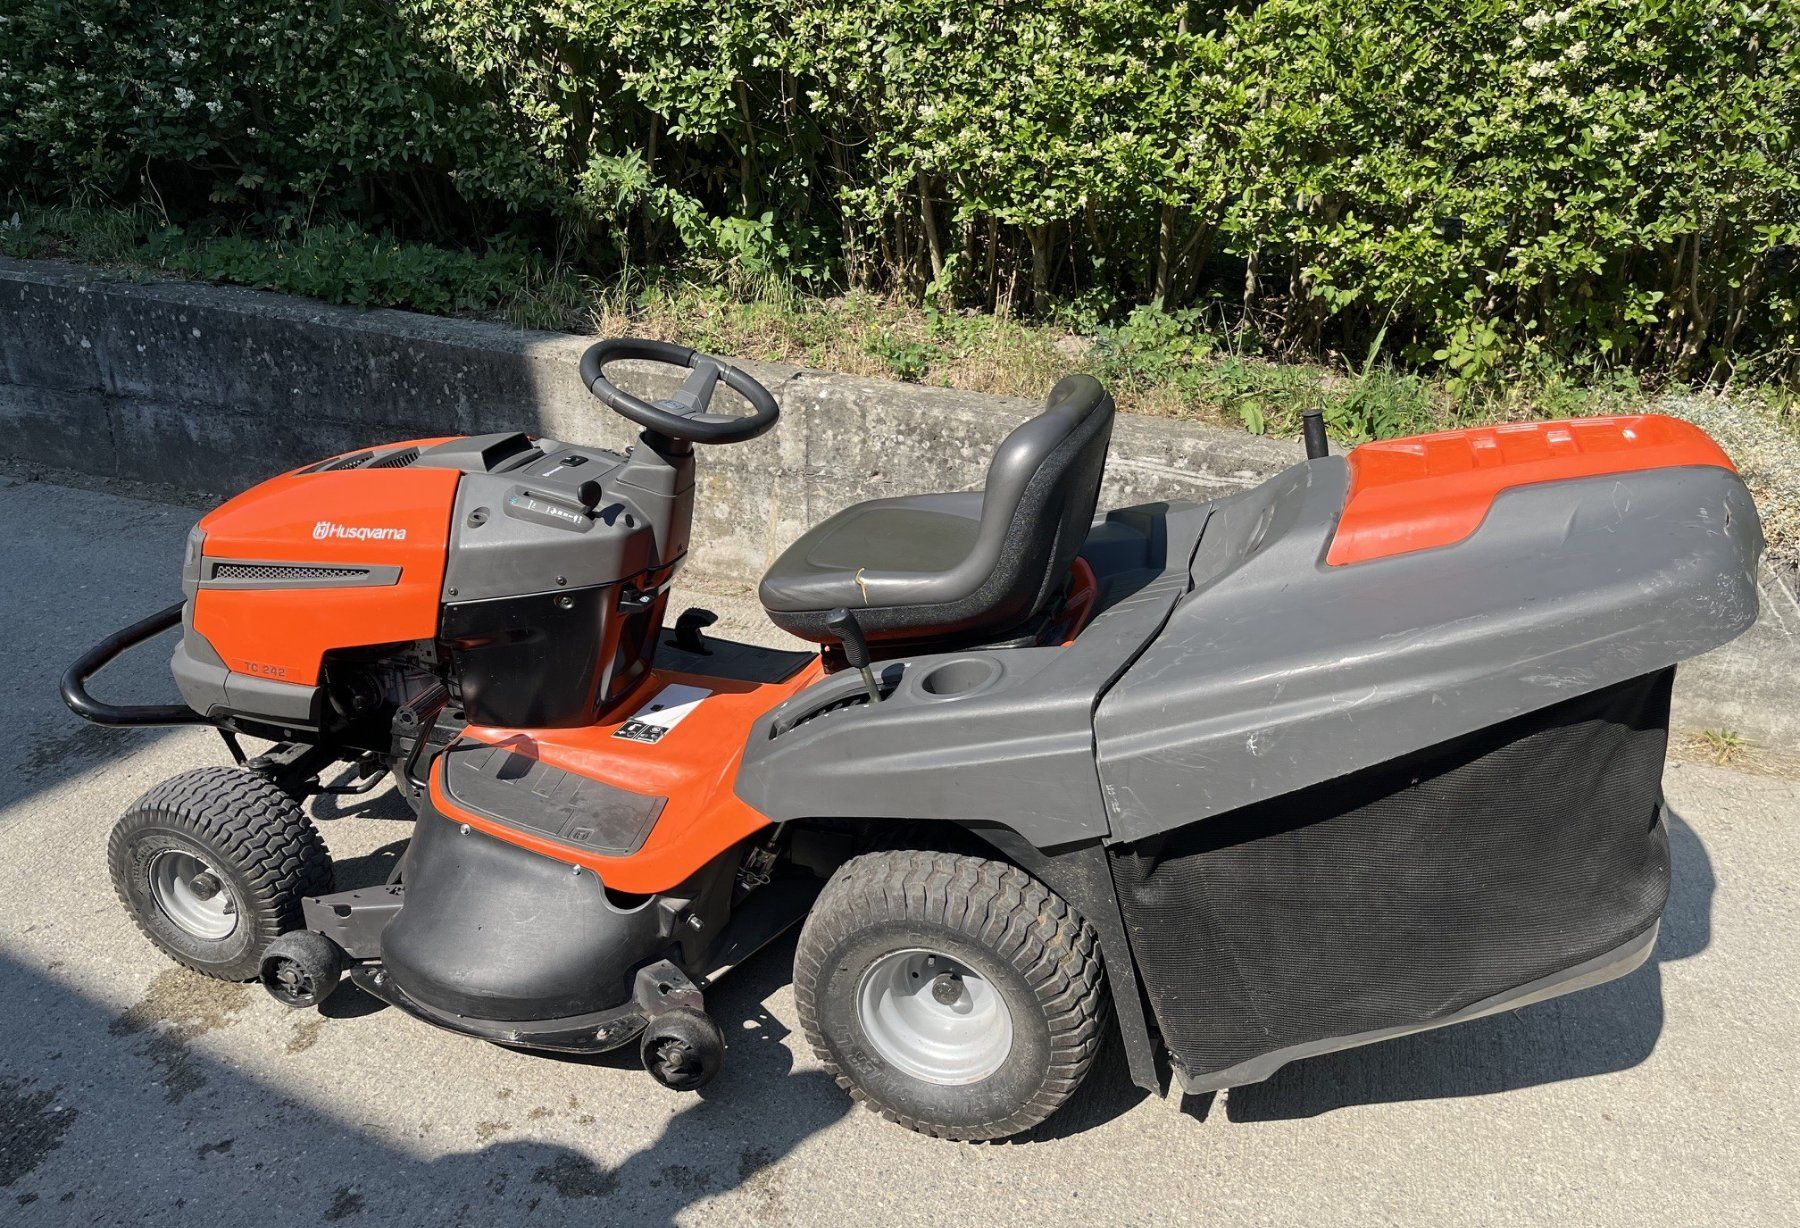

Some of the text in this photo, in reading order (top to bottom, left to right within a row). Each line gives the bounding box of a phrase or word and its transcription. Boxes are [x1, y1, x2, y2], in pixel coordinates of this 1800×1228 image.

[329, 524, 407, 541] Husqvarna
[244, 661, 285, 677] TC 242
